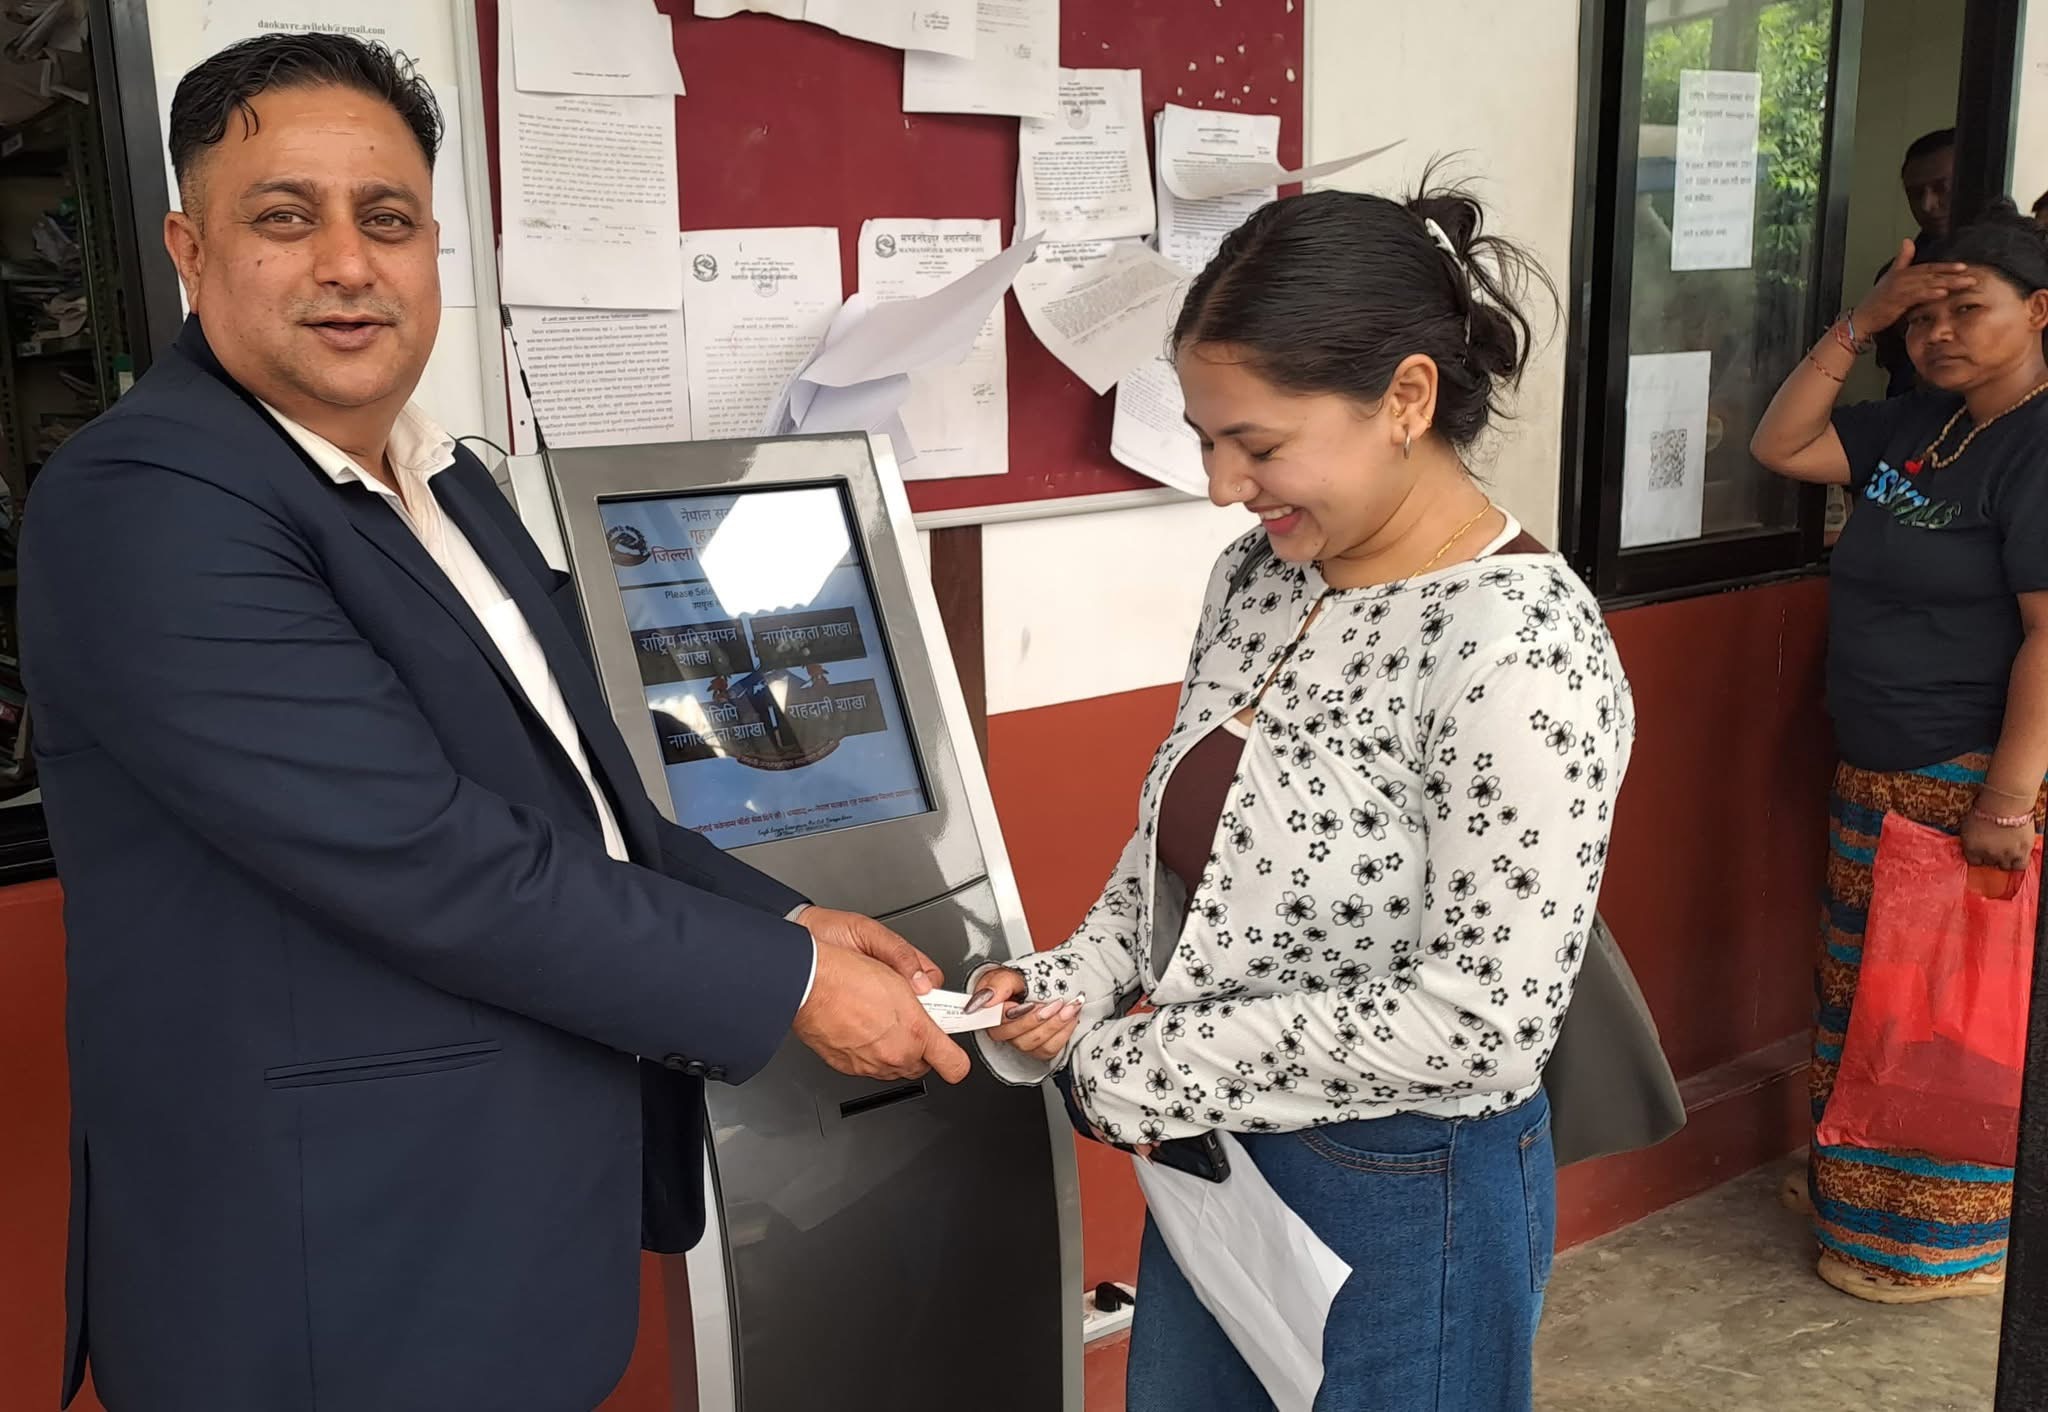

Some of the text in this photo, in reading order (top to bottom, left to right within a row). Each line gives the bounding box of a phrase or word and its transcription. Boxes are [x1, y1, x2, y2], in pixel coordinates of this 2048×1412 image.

[680, 507, 712, 522] नेपाल
[651, 546, 695, 563] जिल्ला
[664, 589, 694, 600] Please
[678, 628, 738, 648] परिचयपत्र
[760, 622, 853, 645] नागरिकता शाखा
[676, 650, 711, 666] शाखा
[787, 695, 867, 718] राहदानी शाखा
